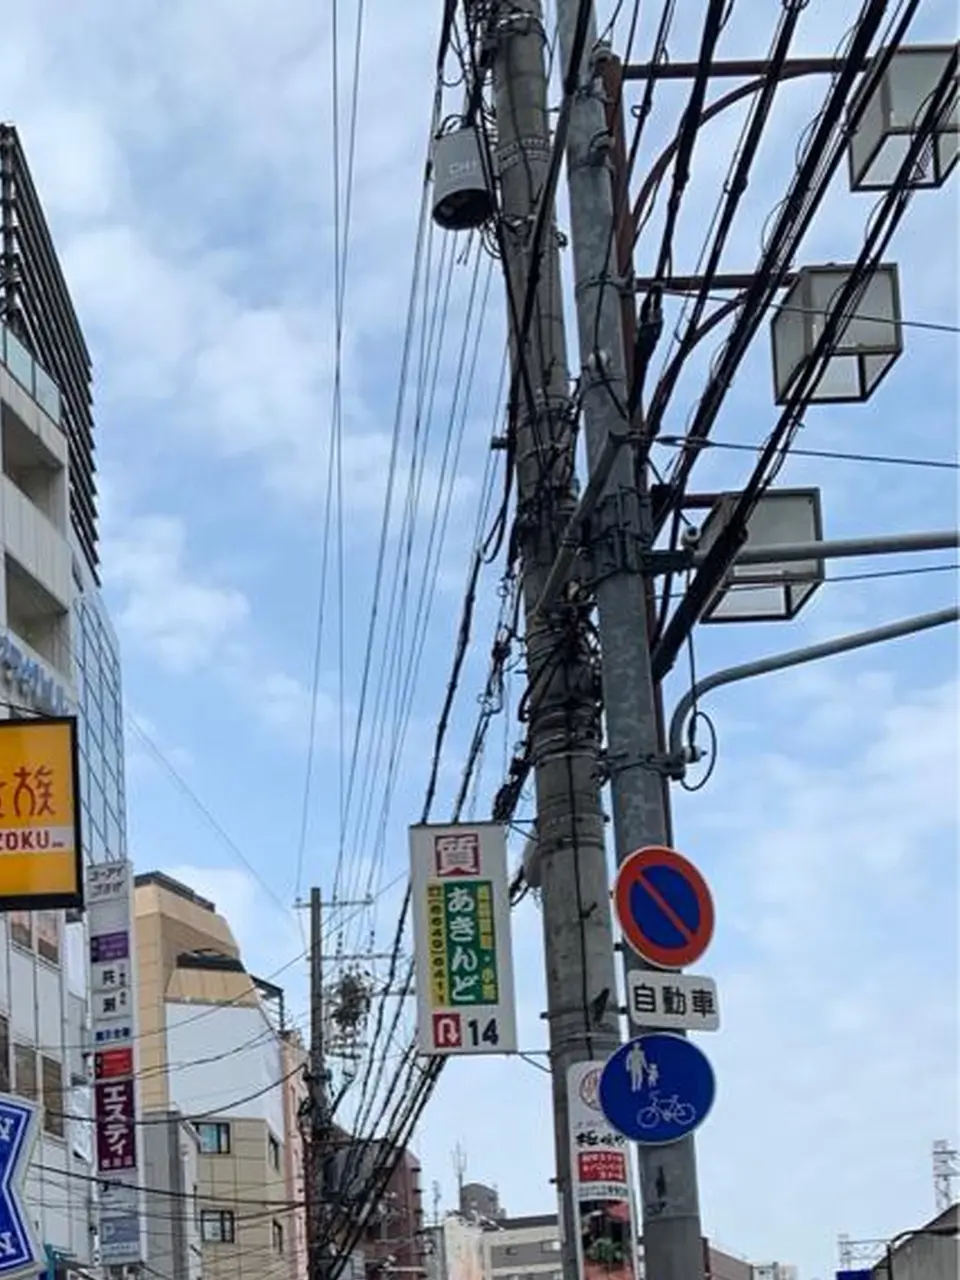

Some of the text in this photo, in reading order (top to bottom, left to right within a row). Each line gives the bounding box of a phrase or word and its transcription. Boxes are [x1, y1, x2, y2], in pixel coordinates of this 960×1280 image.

[436, 835, 479, 876] 質
[447, 886, 479, 1001] あきんど
[633, 984, 717, 1018] 自動車
[467, 1017, 499, 1046] 14
[103, 1085, 128, 1156] エスティ
